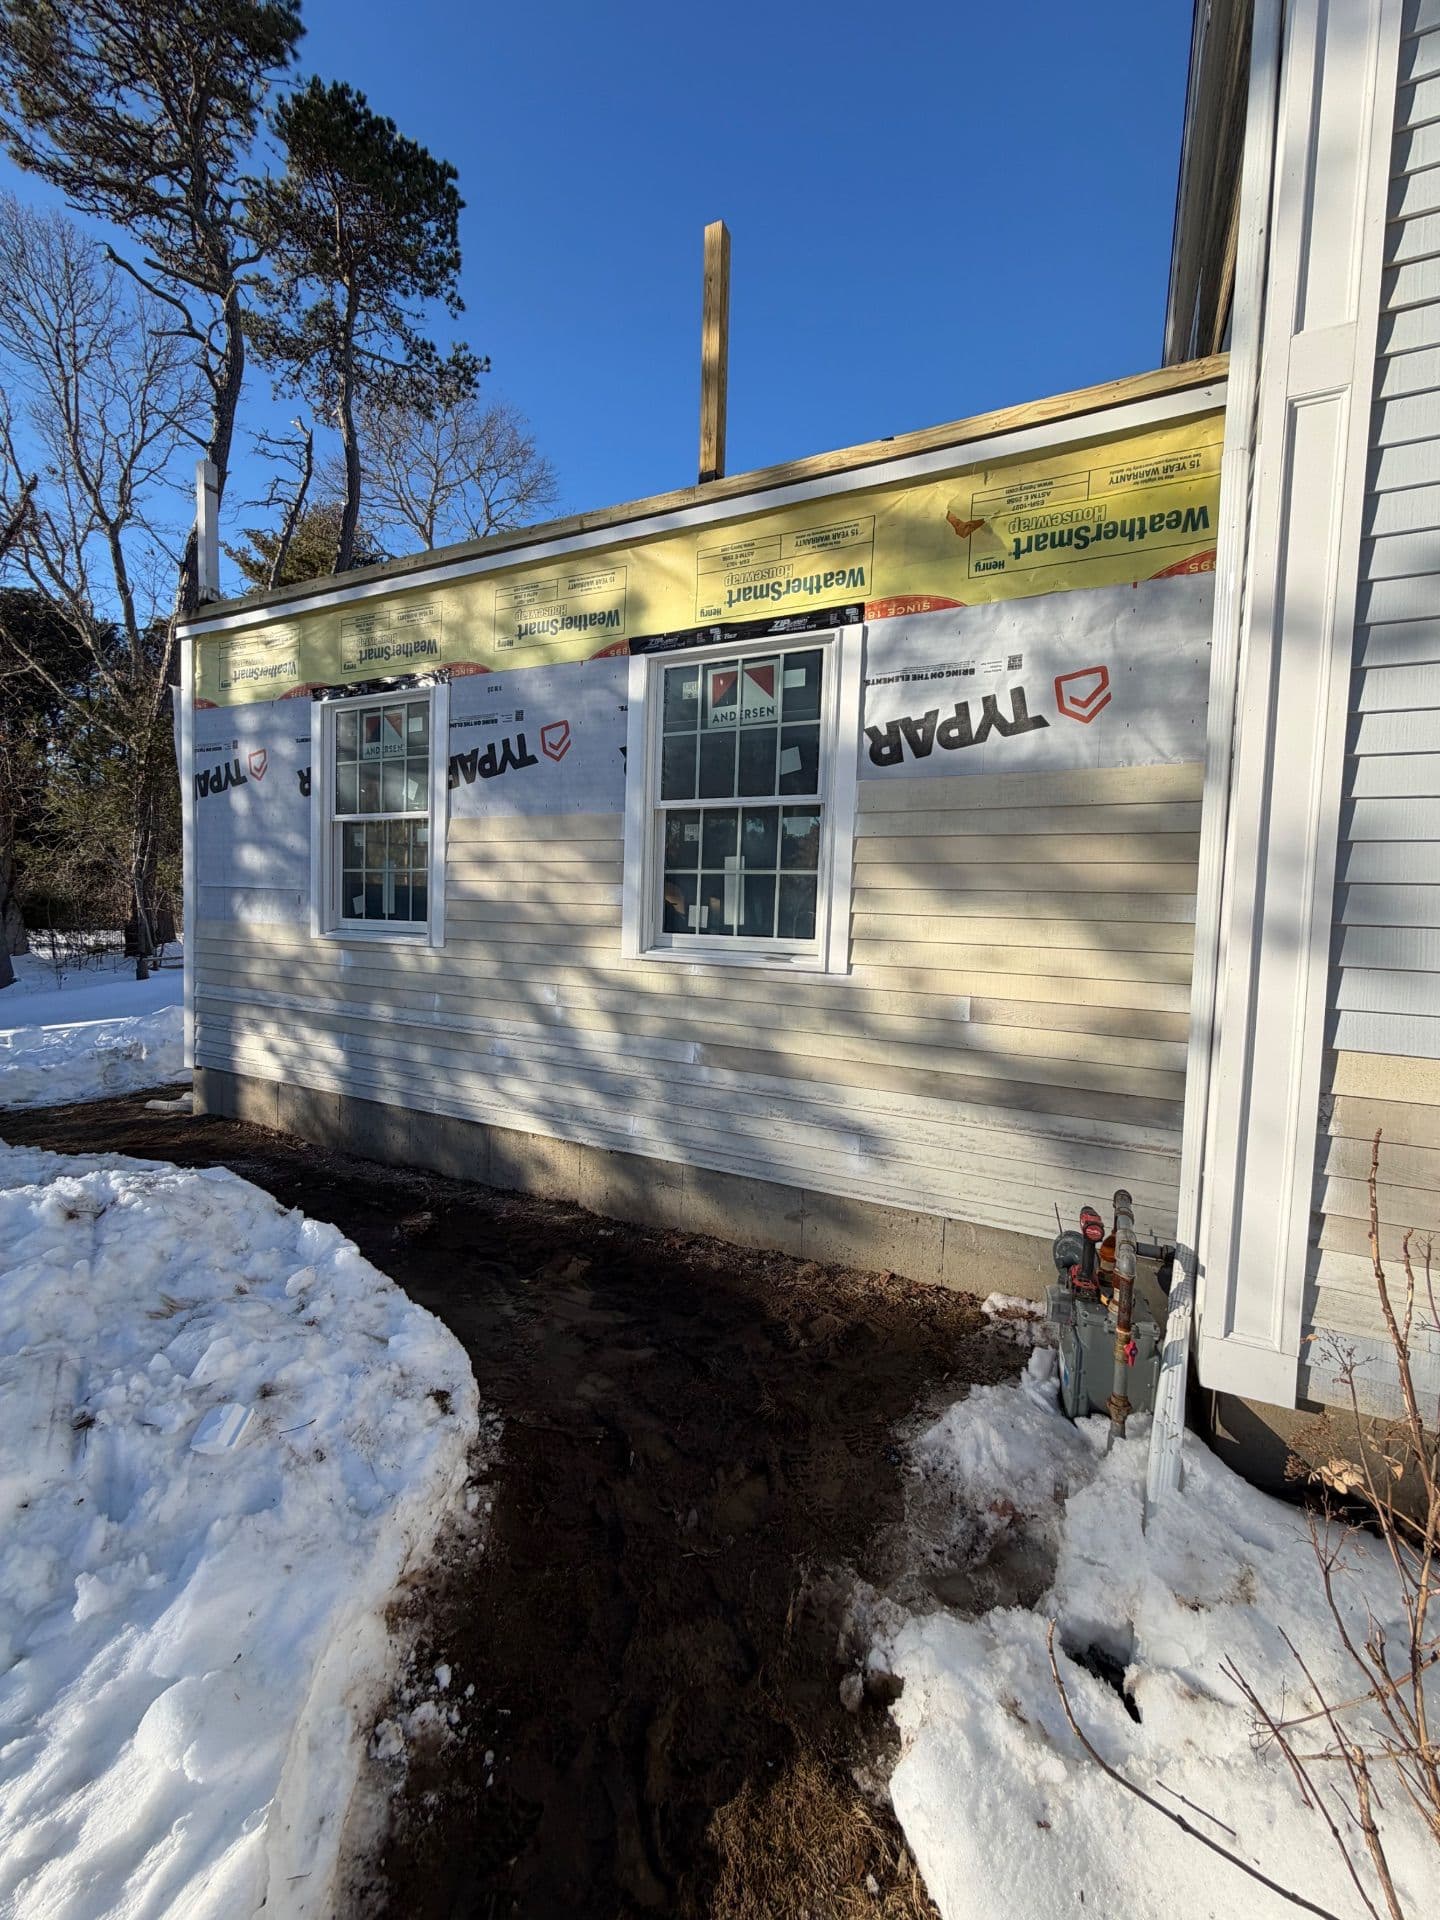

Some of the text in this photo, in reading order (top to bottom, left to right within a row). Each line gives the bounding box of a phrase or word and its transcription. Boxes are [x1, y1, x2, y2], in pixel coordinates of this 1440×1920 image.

[1109, 459, 1201, 485] 15 YEAR WARRANTY
[1008, 504, 1107, 535] Housewrap
[794, 534, 831, 548] WARRANTY
[832, 530, 849, 541] YEAR
[1012, 506, 1210, 560] WeatherSmart
[724, 563, 794, 587] Housewrap
[974, 558, 1005, 573] Henry
[725, 566, 865, 608] WeatherSmart
[700, 607, 722, 618] Henry
[887, 602, 930, 617] SINCE
[516, 609, 620, 640] WeatherSmart
[358, 638, 438, 665] WeatherSmart
[911, 672, 929, 682] THE
[945, 668, 976, 678] BRING
[864, 686, 1050, 767] TYPAR
[194, 758, 248, 801] TYPA
